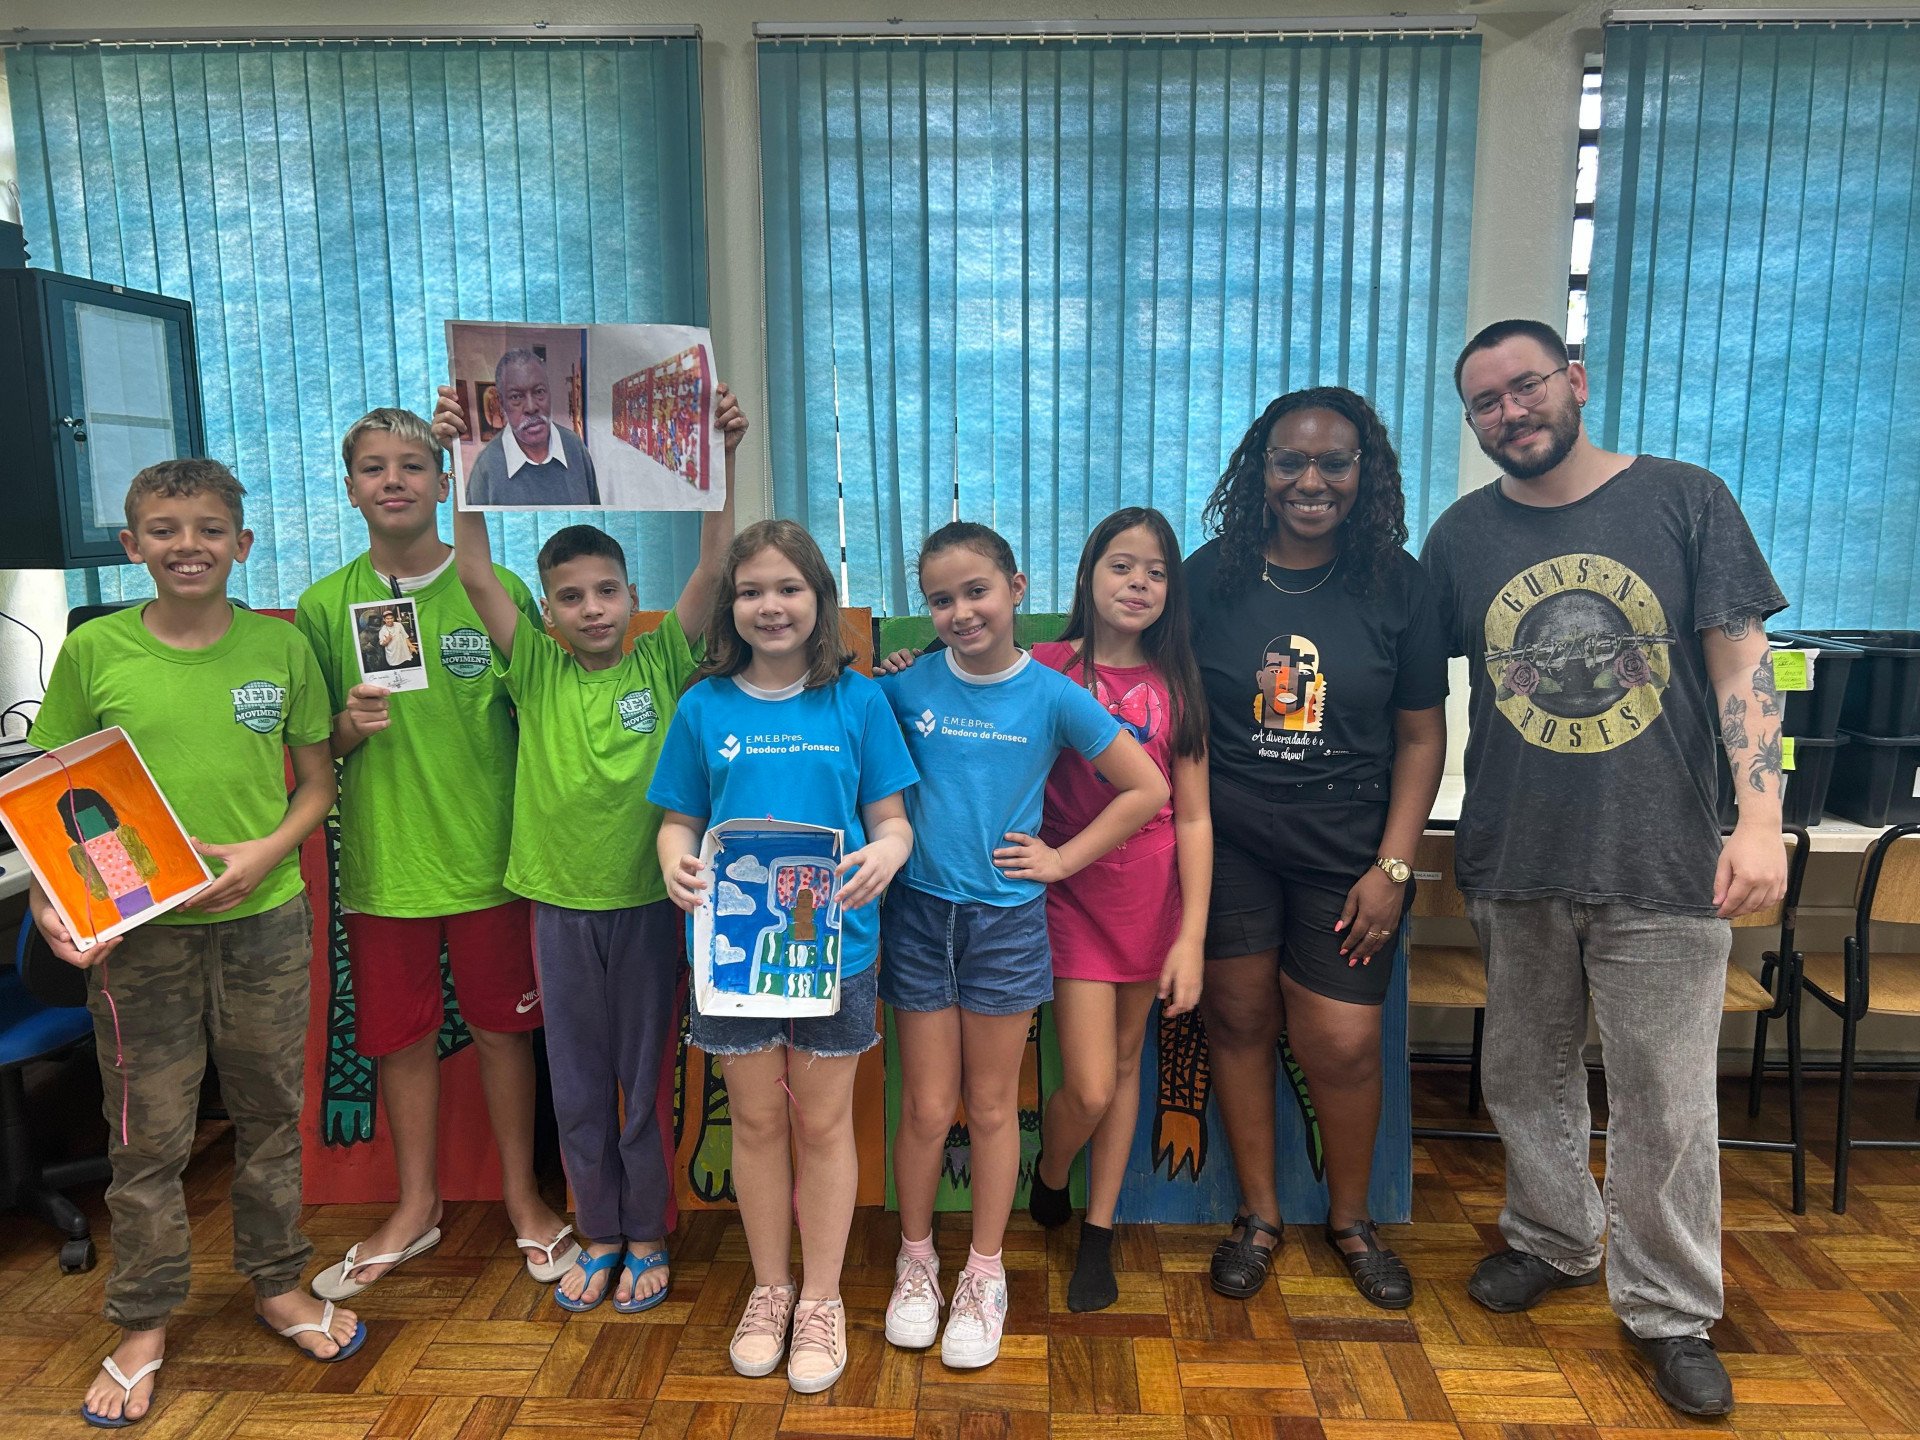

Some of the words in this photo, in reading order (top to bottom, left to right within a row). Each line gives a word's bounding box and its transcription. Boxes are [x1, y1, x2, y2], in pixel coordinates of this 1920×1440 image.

[615, 689, 651, 714] RED
[975, 719, 996, 729] Pres.
[782, 734, 805, 742] Pres.
[941, 726, 978, 738] Deodoro
[980, 731, 991, 739] da
[992, 731, 1028, 743] Fonseca
[1265, 730, 1312, 746] diversidade
[1318, 738, 1325, 746] o
[746, 745, 787, 755] Deodoro
[789, 744, 800, 752] da
[802, 743, 840, 752] Fonseca
[1258, 747, 1279, 759] nosso
